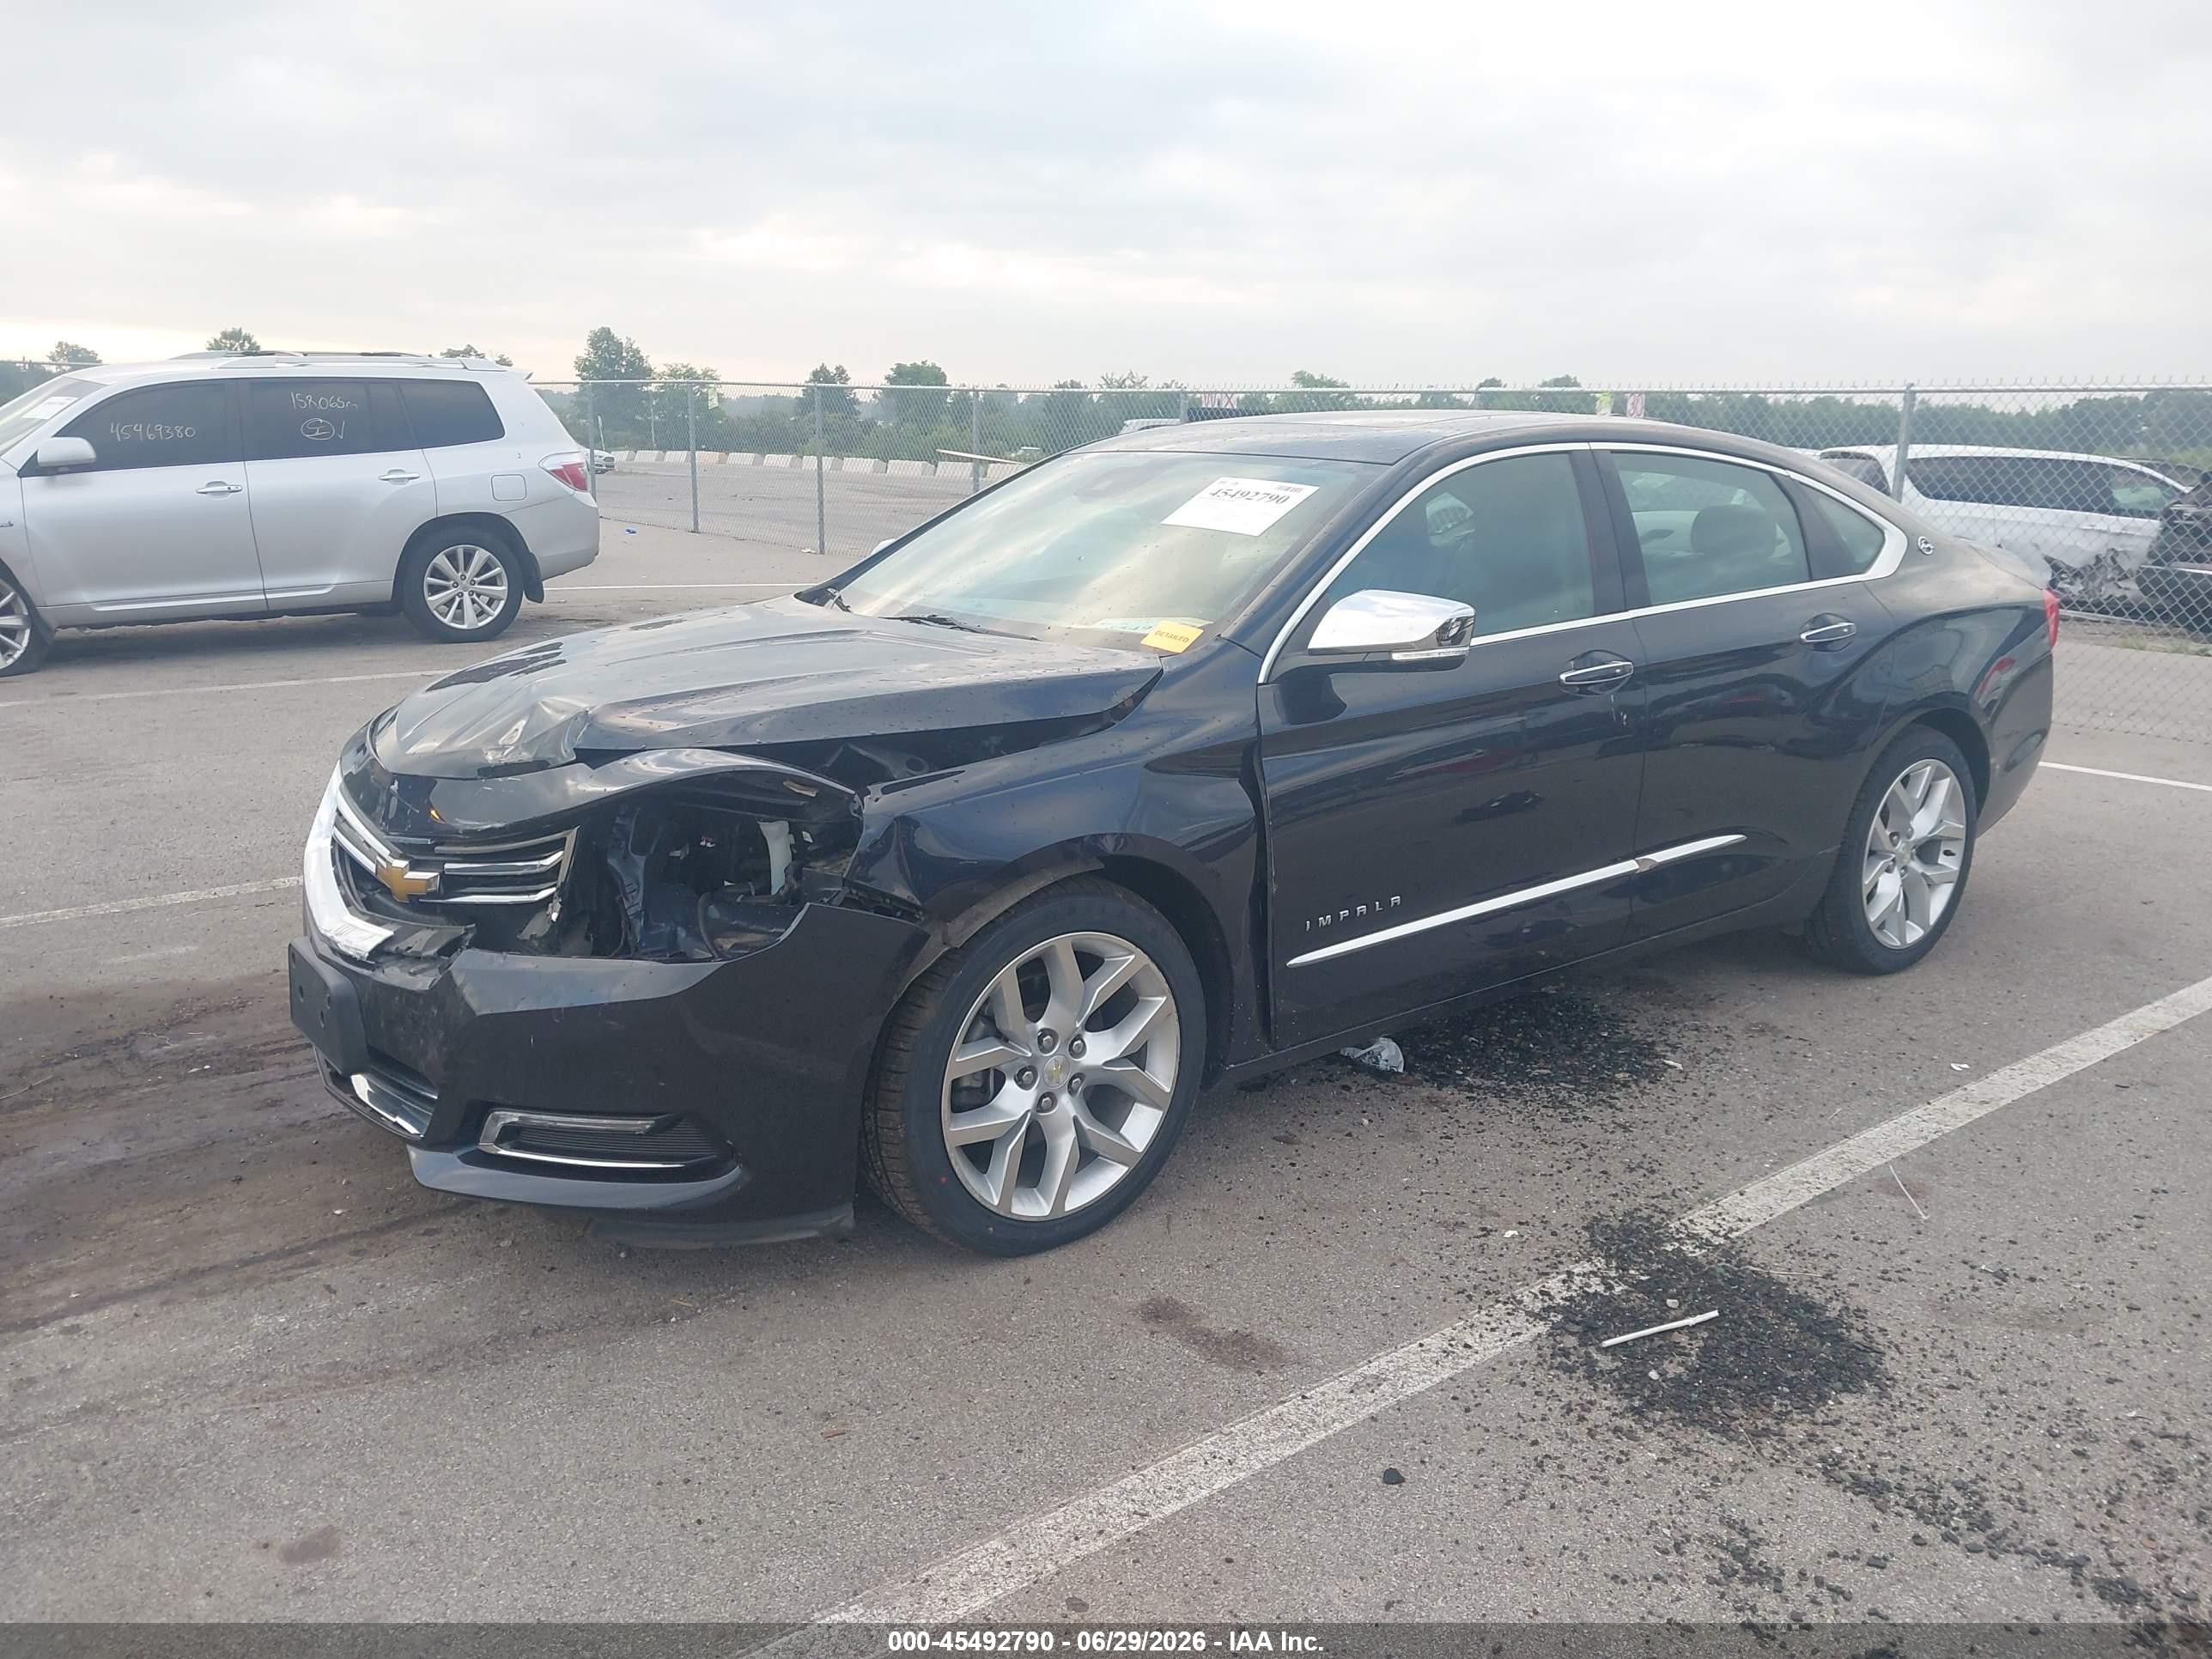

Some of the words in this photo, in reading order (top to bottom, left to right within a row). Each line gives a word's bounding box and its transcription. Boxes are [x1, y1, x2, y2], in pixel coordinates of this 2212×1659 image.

[110, 422, 196, 442] 45469380
[1209, 488, 1291, 504] 45492790
[1305, 896, 1401, 931] IMPALA
